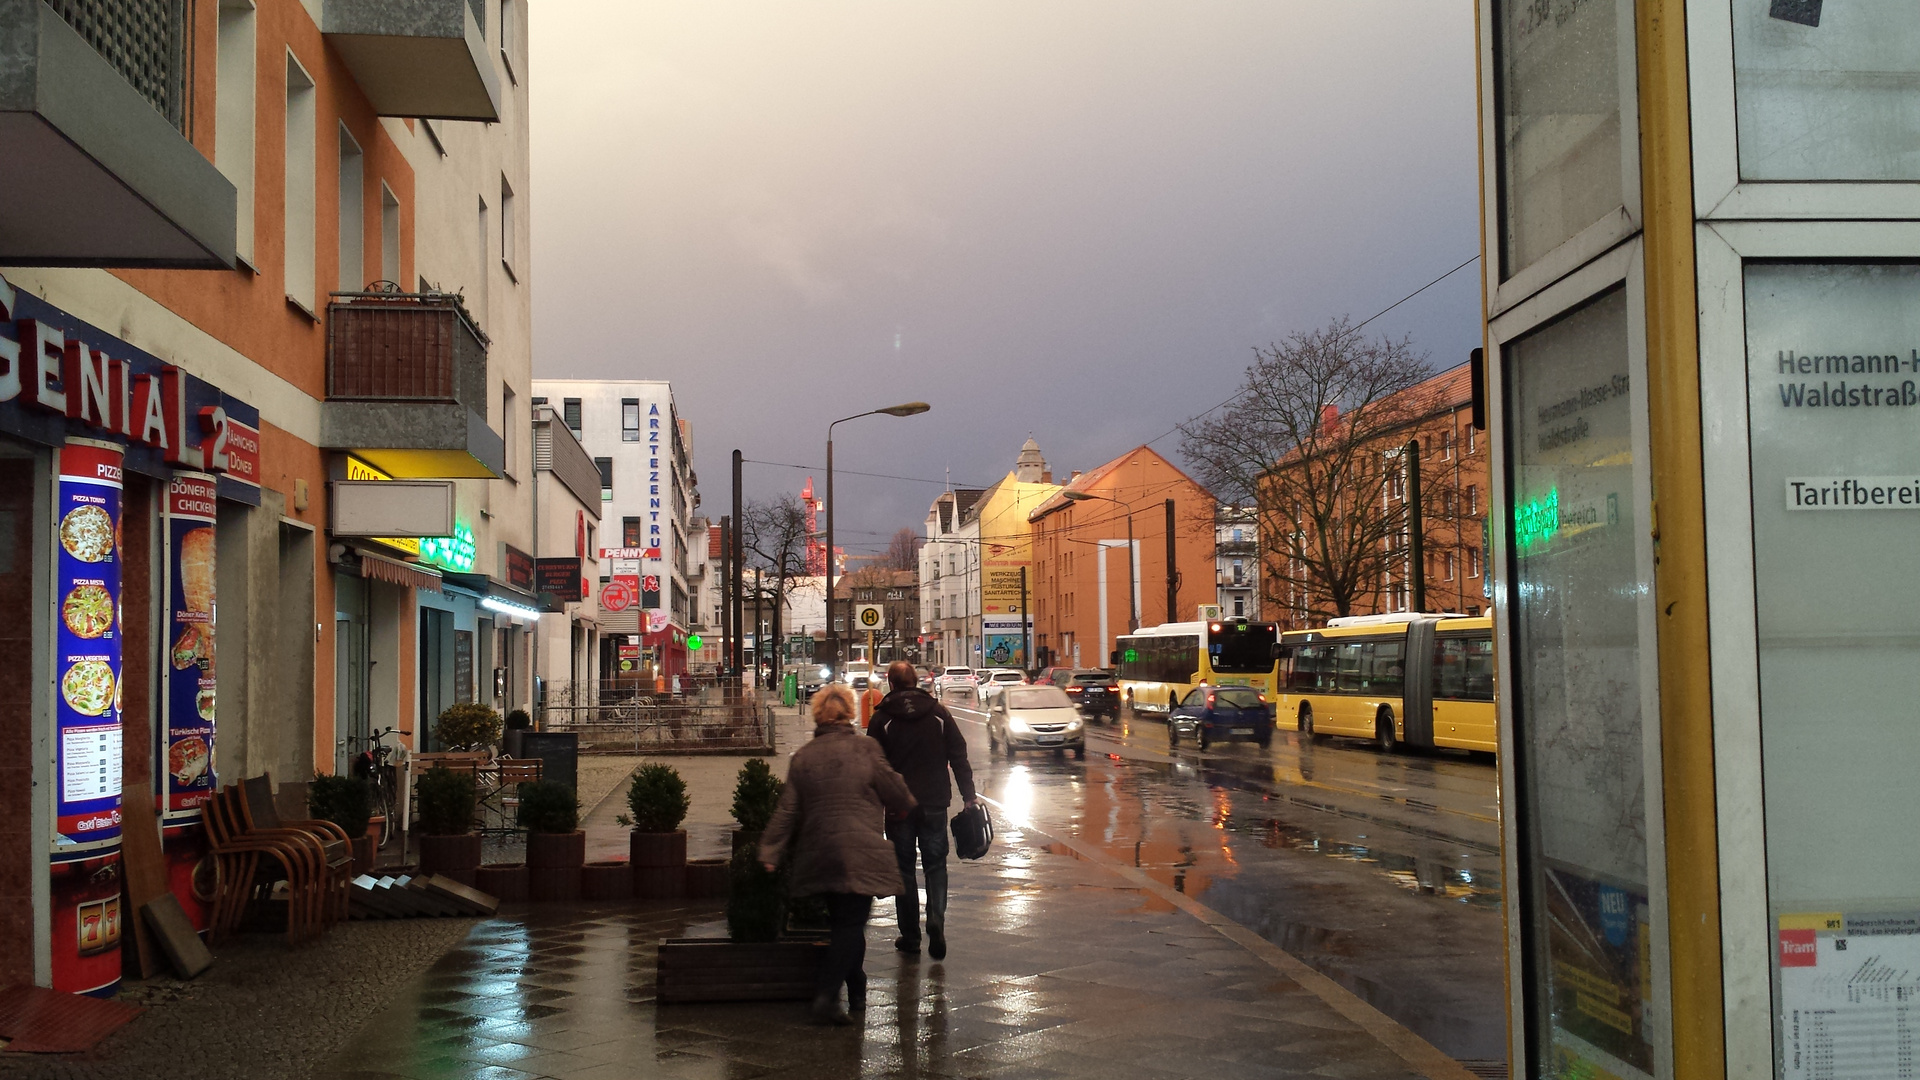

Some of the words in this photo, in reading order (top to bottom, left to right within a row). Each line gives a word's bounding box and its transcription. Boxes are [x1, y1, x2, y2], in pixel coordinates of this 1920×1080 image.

[1778, 380, 1920, 407] Waldstraß
[205, 406, 228, 473] 2
[230, 450, 253, 475] DÖNER
[649, 403, 661, 561] ÄRZTEZENTRU
[1600, 892, 1625, 914] NEU
[1781, 940, 1815, 954] Tram
